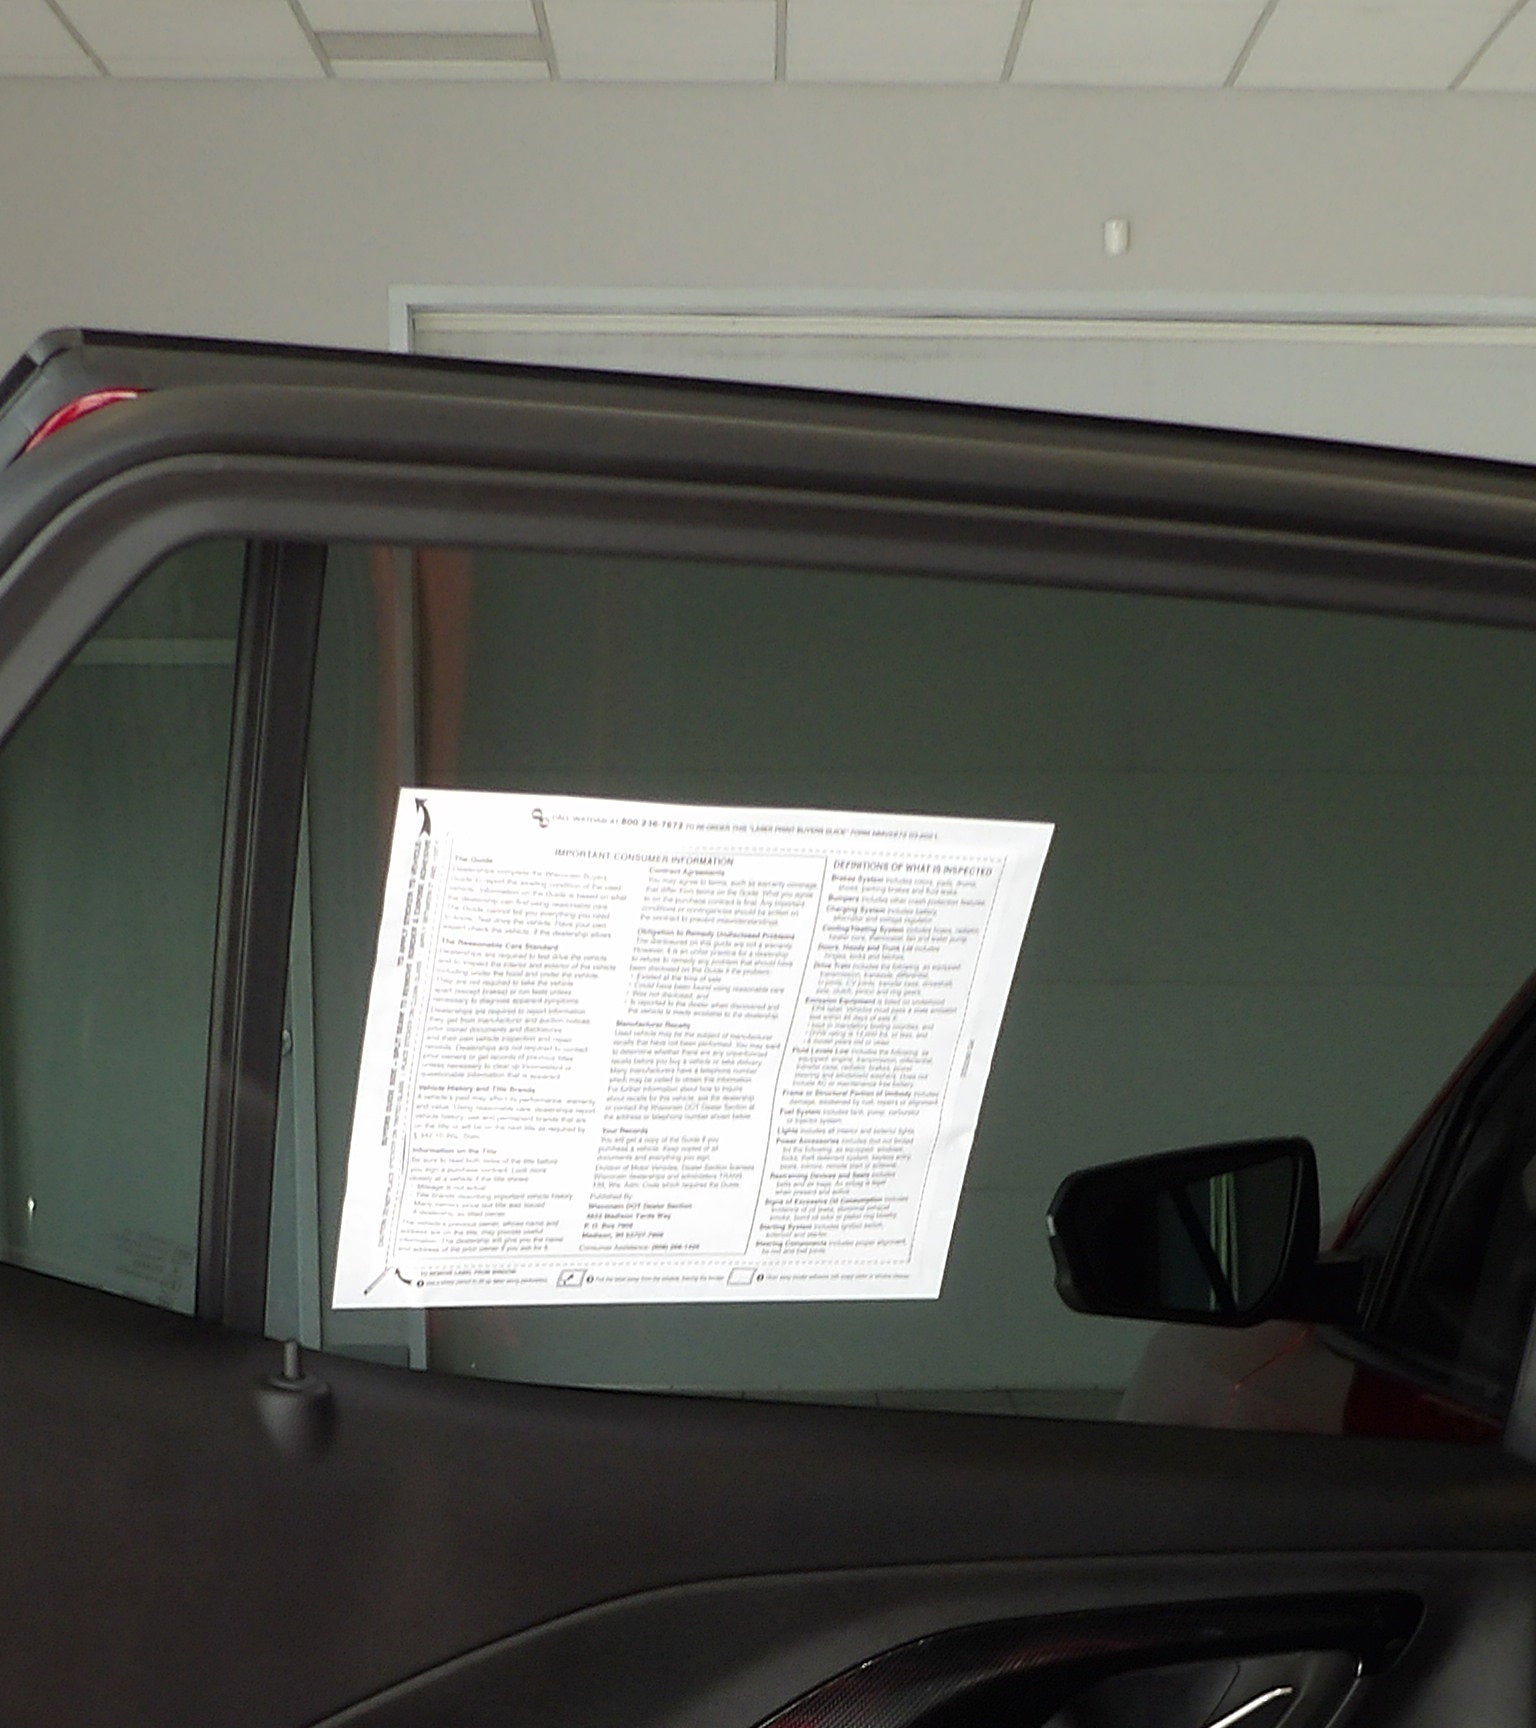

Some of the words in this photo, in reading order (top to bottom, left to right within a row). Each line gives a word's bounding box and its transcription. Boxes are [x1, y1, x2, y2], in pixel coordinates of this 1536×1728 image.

[554, 848, 611, 859] IMPORTANT
[613, 852, 668, 863] CONSUMER
[670, 855, 734, 866] INFORMATION
[832, 859, 889, 871] DEFINITIONS
[890, 862, 903, 872] OF
[904, 863, 931, 873] WHAT
[931, 864, 942, 874] IS
[942, 865, 993, 876] INSPECTED
